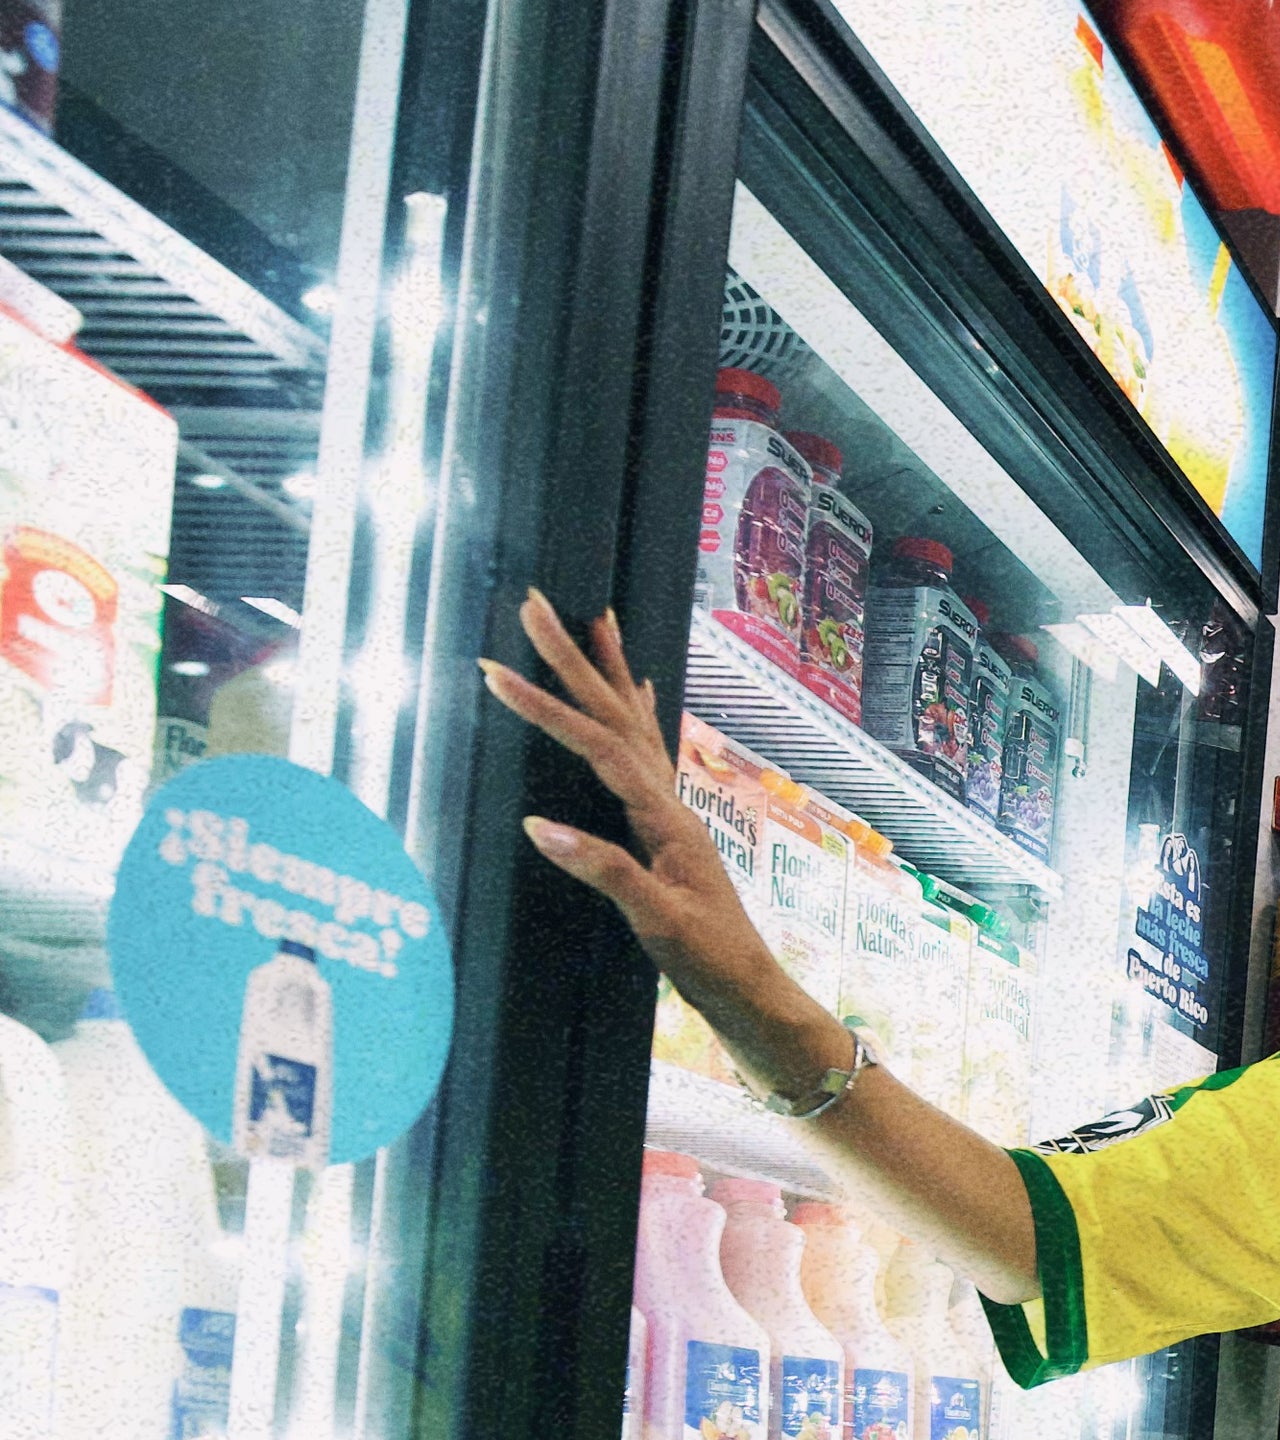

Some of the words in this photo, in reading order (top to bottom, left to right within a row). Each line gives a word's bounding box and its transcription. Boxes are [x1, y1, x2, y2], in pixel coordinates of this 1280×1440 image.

[1137, 912, 1166, 947] más
[1168, 930, 1210, 978] fresca
[1149, 896, 1164, 922] la
[1166, 903, 1202, 948] leche
[1129, 954, 1178, 1004] Puerto
[1179, 986, 1210, 1025] Rico
[1163, 951, 1182, 982] de
